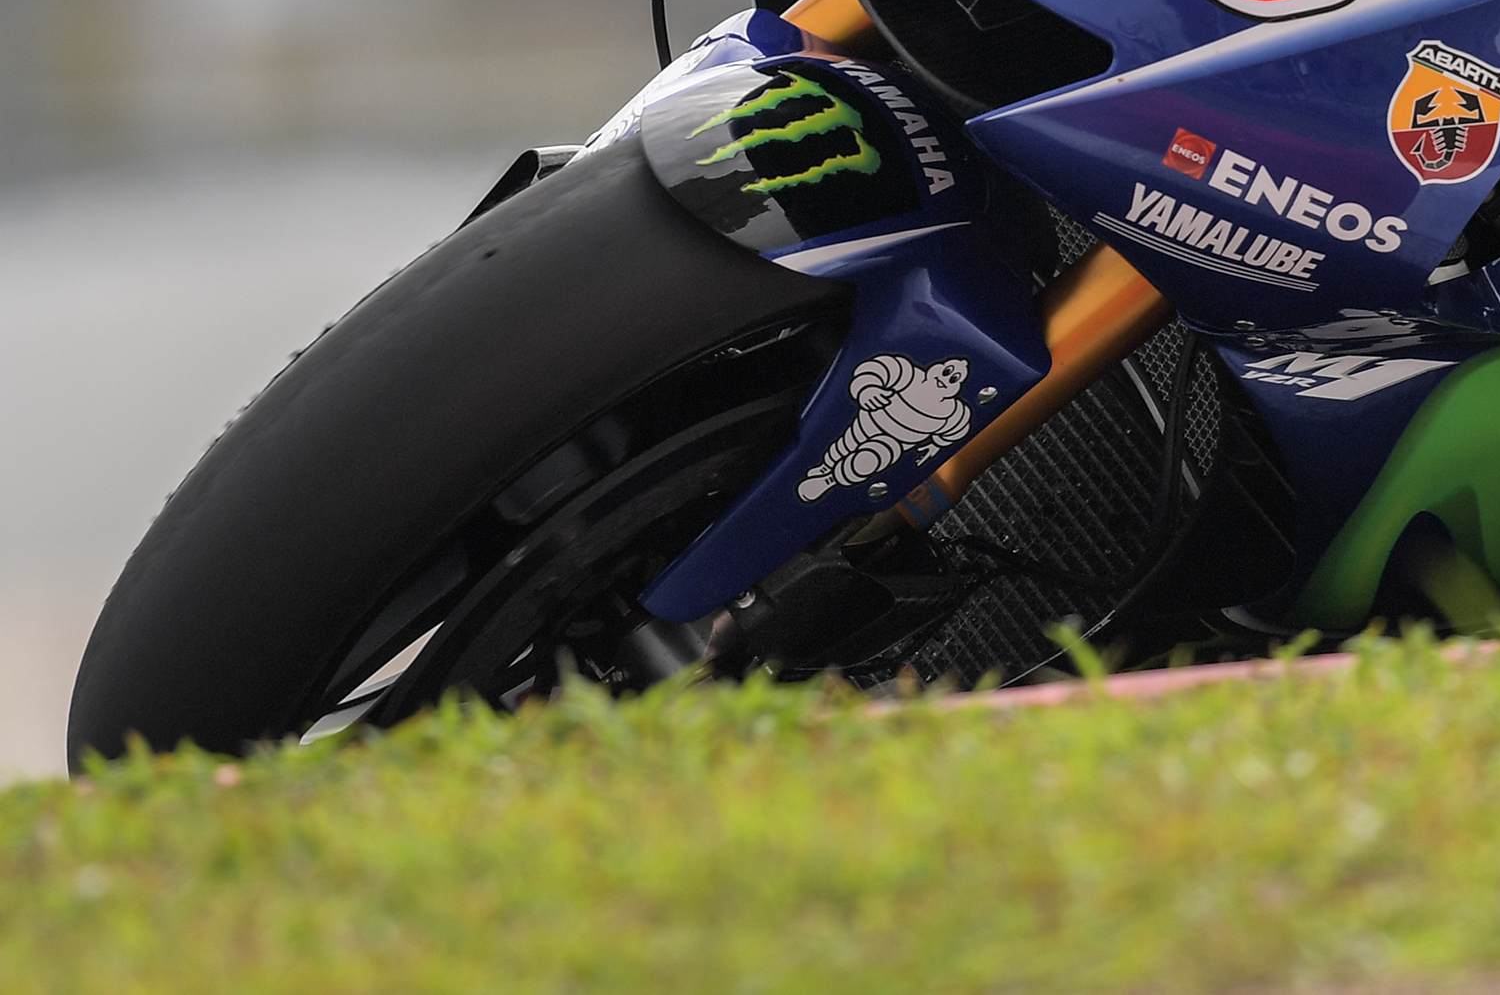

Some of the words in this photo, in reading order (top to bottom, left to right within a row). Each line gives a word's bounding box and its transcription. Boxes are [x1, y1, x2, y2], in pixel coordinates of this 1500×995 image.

[829, 60, 955, 195] YAMAHA
[1171, 143, 1207, 166] ENEOS
[1124, 182, 1326, 279] YAMALUBE
[1208, 149, 1408, 253] ENEOS
[1243, 351, 1461, 402] M1
